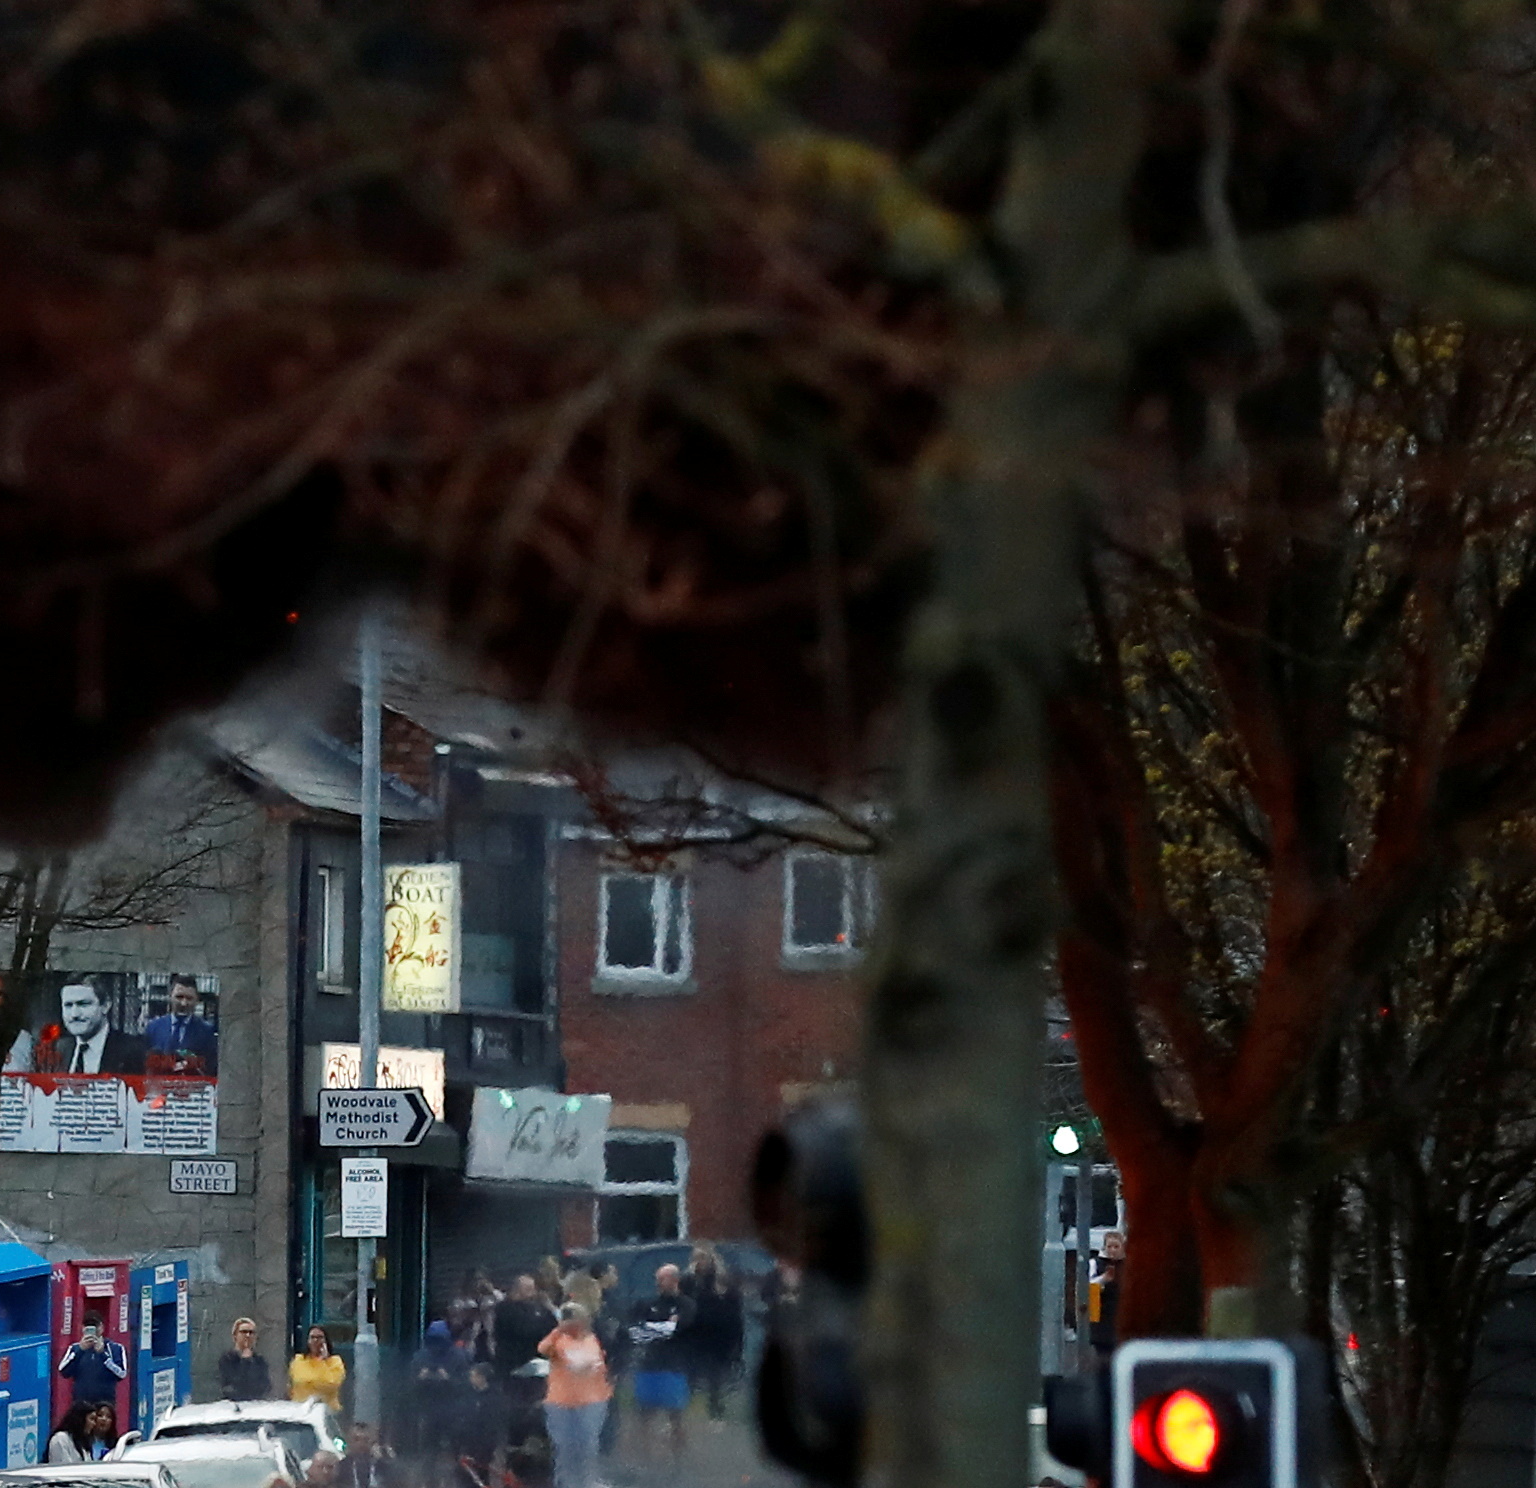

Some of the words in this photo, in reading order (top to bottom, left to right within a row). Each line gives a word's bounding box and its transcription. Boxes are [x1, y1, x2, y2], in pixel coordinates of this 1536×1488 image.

[391, 886, 449, 904] BOAT
[326, 1095, 397, 1108] Woodvale
[325, 1111, 399, 1124] Methodist
[335, 1127, 388, 1139] Church
[180, 1163, 227, 1176] MAYO
[348, 1168, 381, 1176] ALCOHOL
[174, 1178, 232, 1191] STREET
